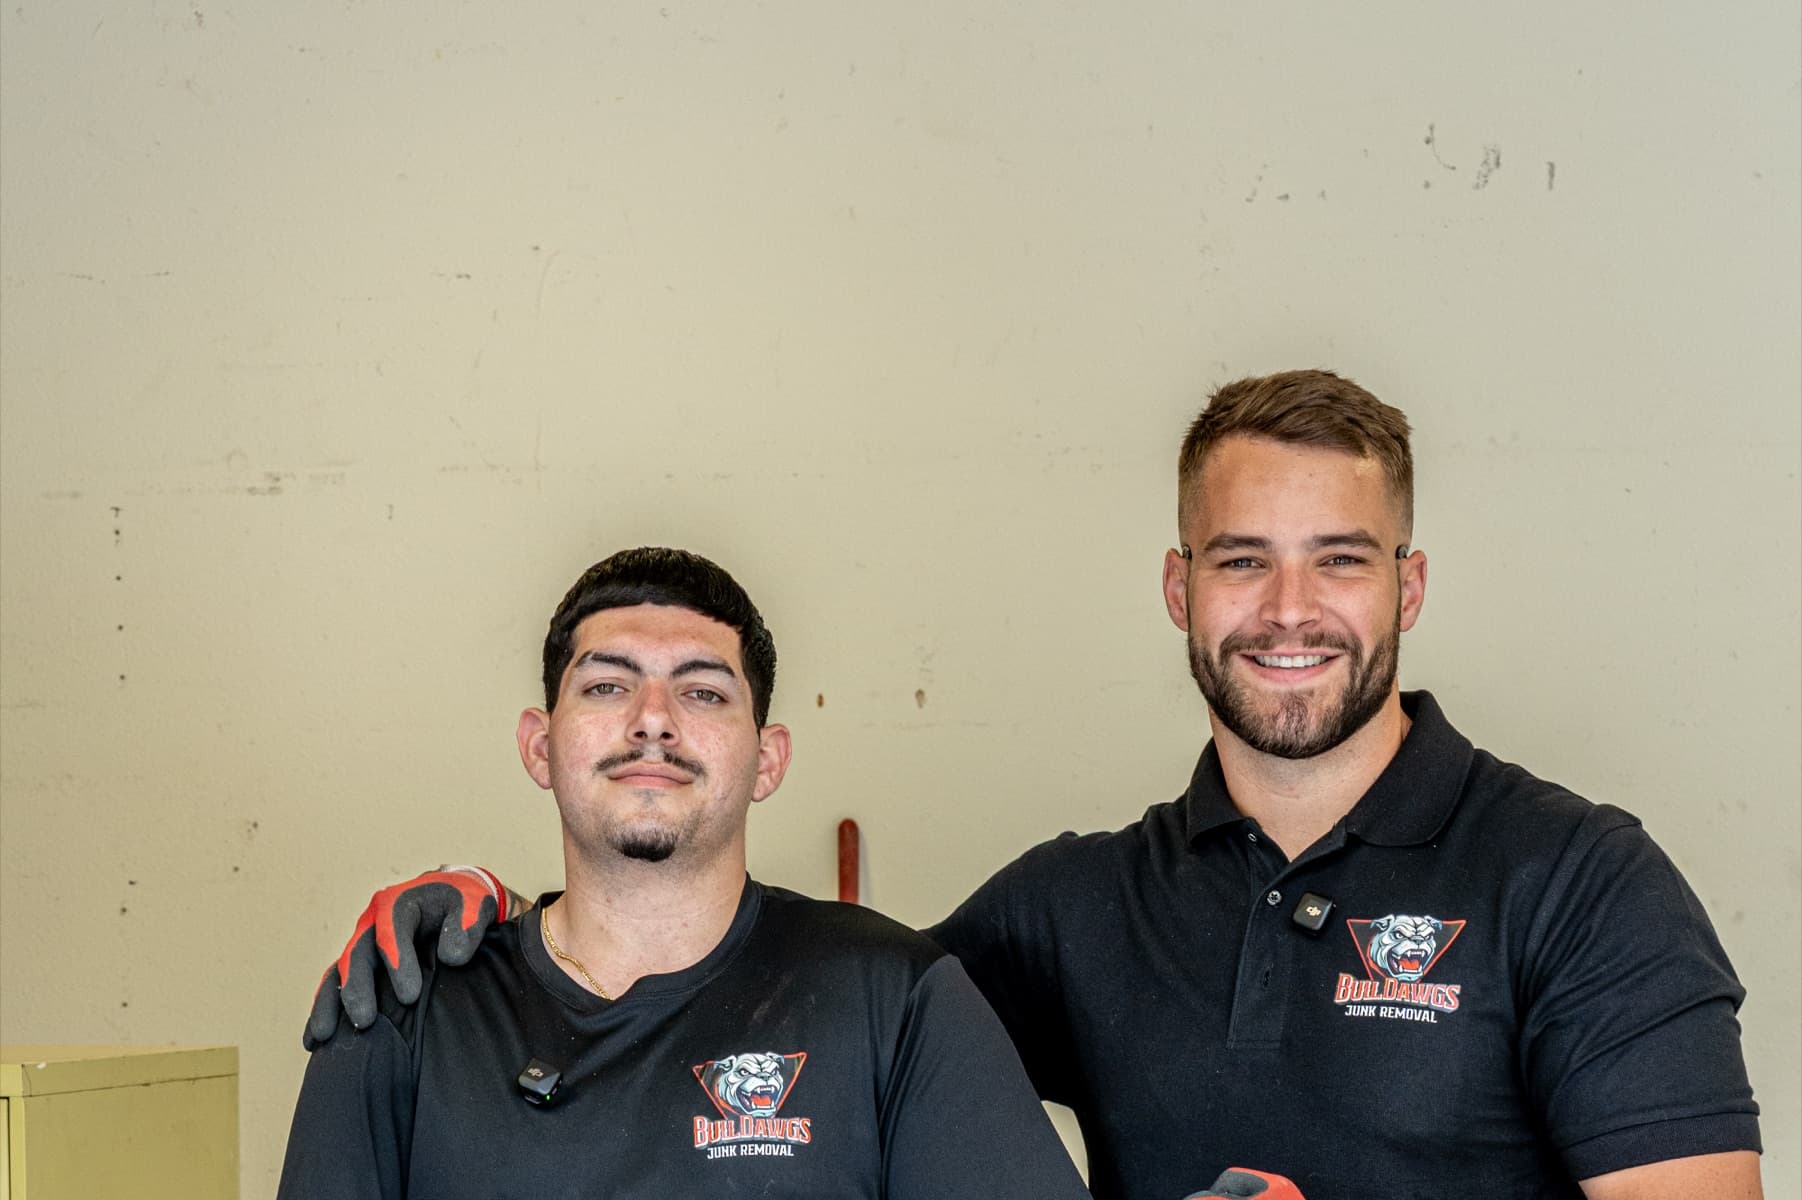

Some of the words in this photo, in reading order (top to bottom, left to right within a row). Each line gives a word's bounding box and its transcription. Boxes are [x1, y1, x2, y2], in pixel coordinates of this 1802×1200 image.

[1345, 1005, 1377, 1017] JUNK
[1380, 1006, 1438, 1024] REMOVAL
[707, 1145, 737, 1160] JUNK
[740, 1144, 795, 1157] REMOVAL
